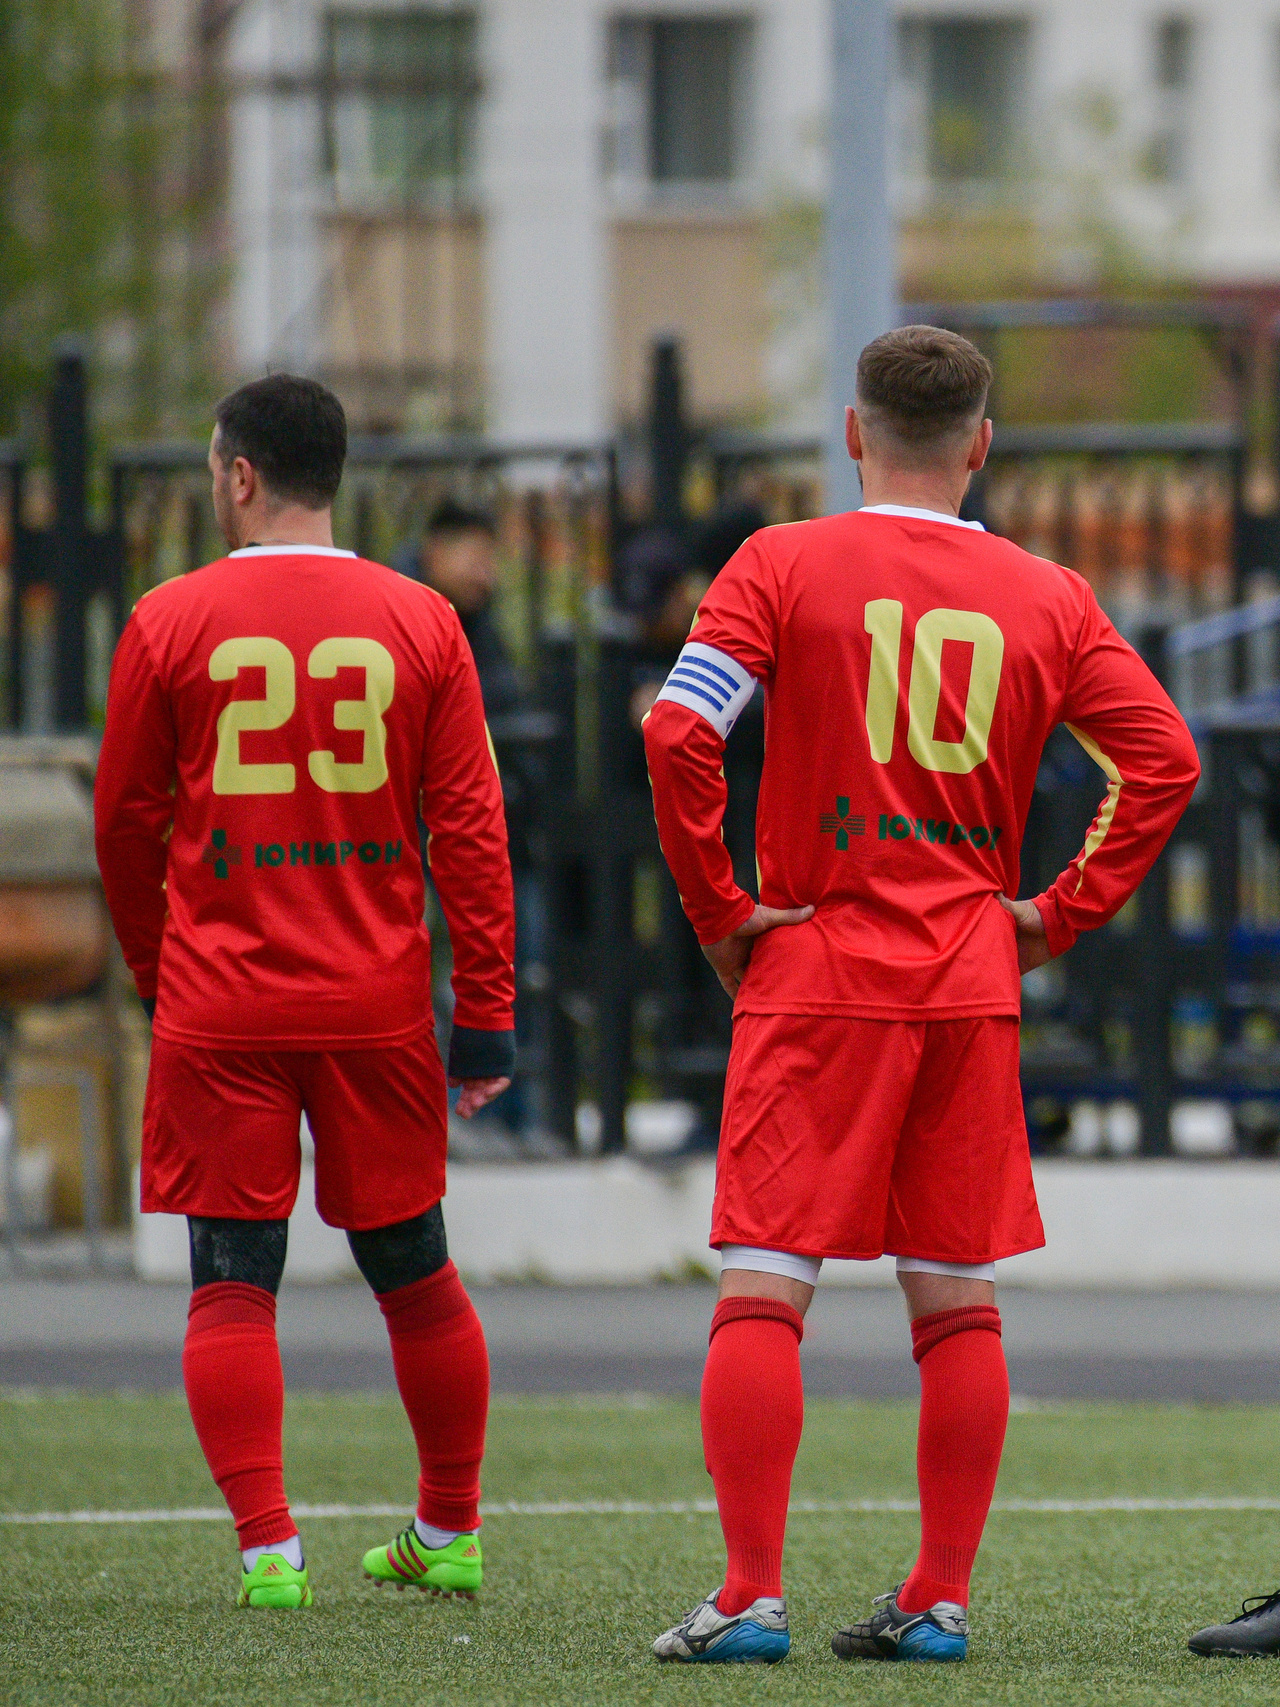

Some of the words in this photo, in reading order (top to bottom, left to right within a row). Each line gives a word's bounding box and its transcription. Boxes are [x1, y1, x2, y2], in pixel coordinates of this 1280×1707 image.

[208, 636, 396, 795] 23
[865, 598, 1004, 775] 10
[254, 840, 402, 868] ЮНИРОН
